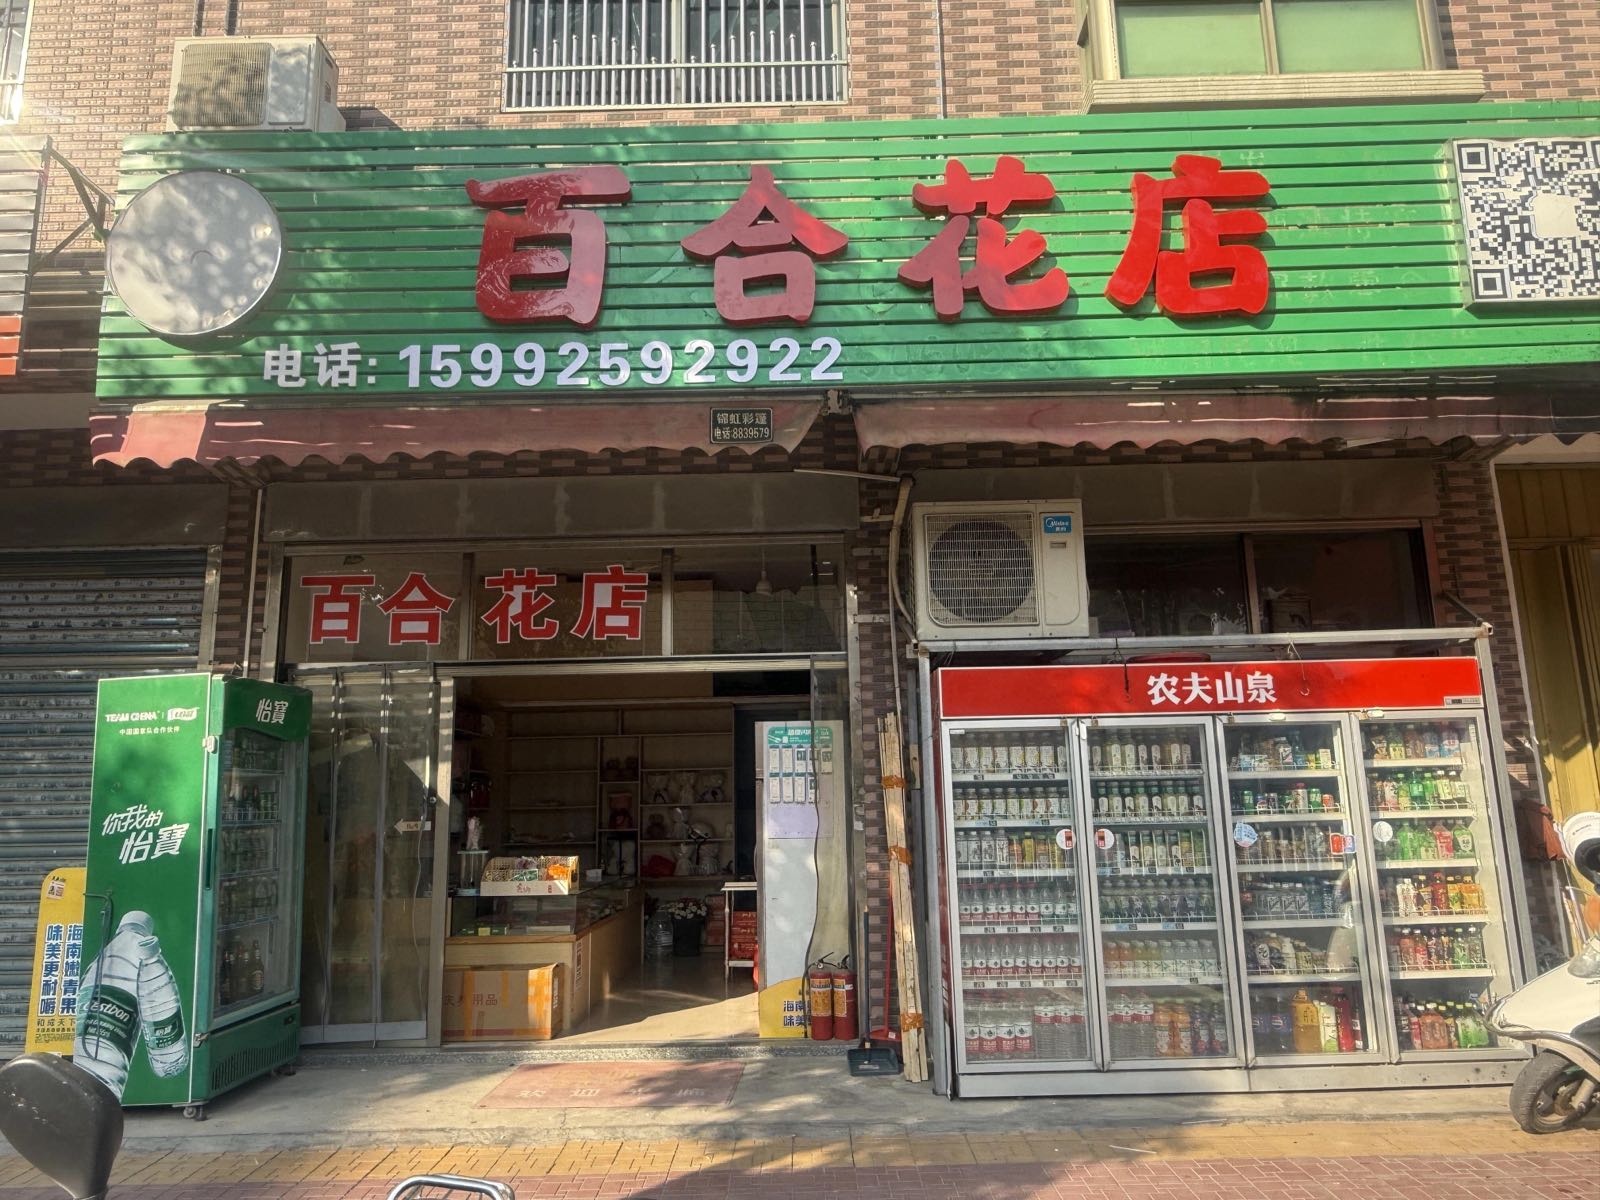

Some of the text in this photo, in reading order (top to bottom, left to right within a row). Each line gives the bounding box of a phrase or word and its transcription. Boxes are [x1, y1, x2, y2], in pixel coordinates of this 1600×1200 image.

[466, 153, 1271, 329] 百合花店
[301, 565, 648, 645] 百合花店
[1147, 671, 1277, 705] 农夫山泉
[102, 804, 163, 836] 你我的
